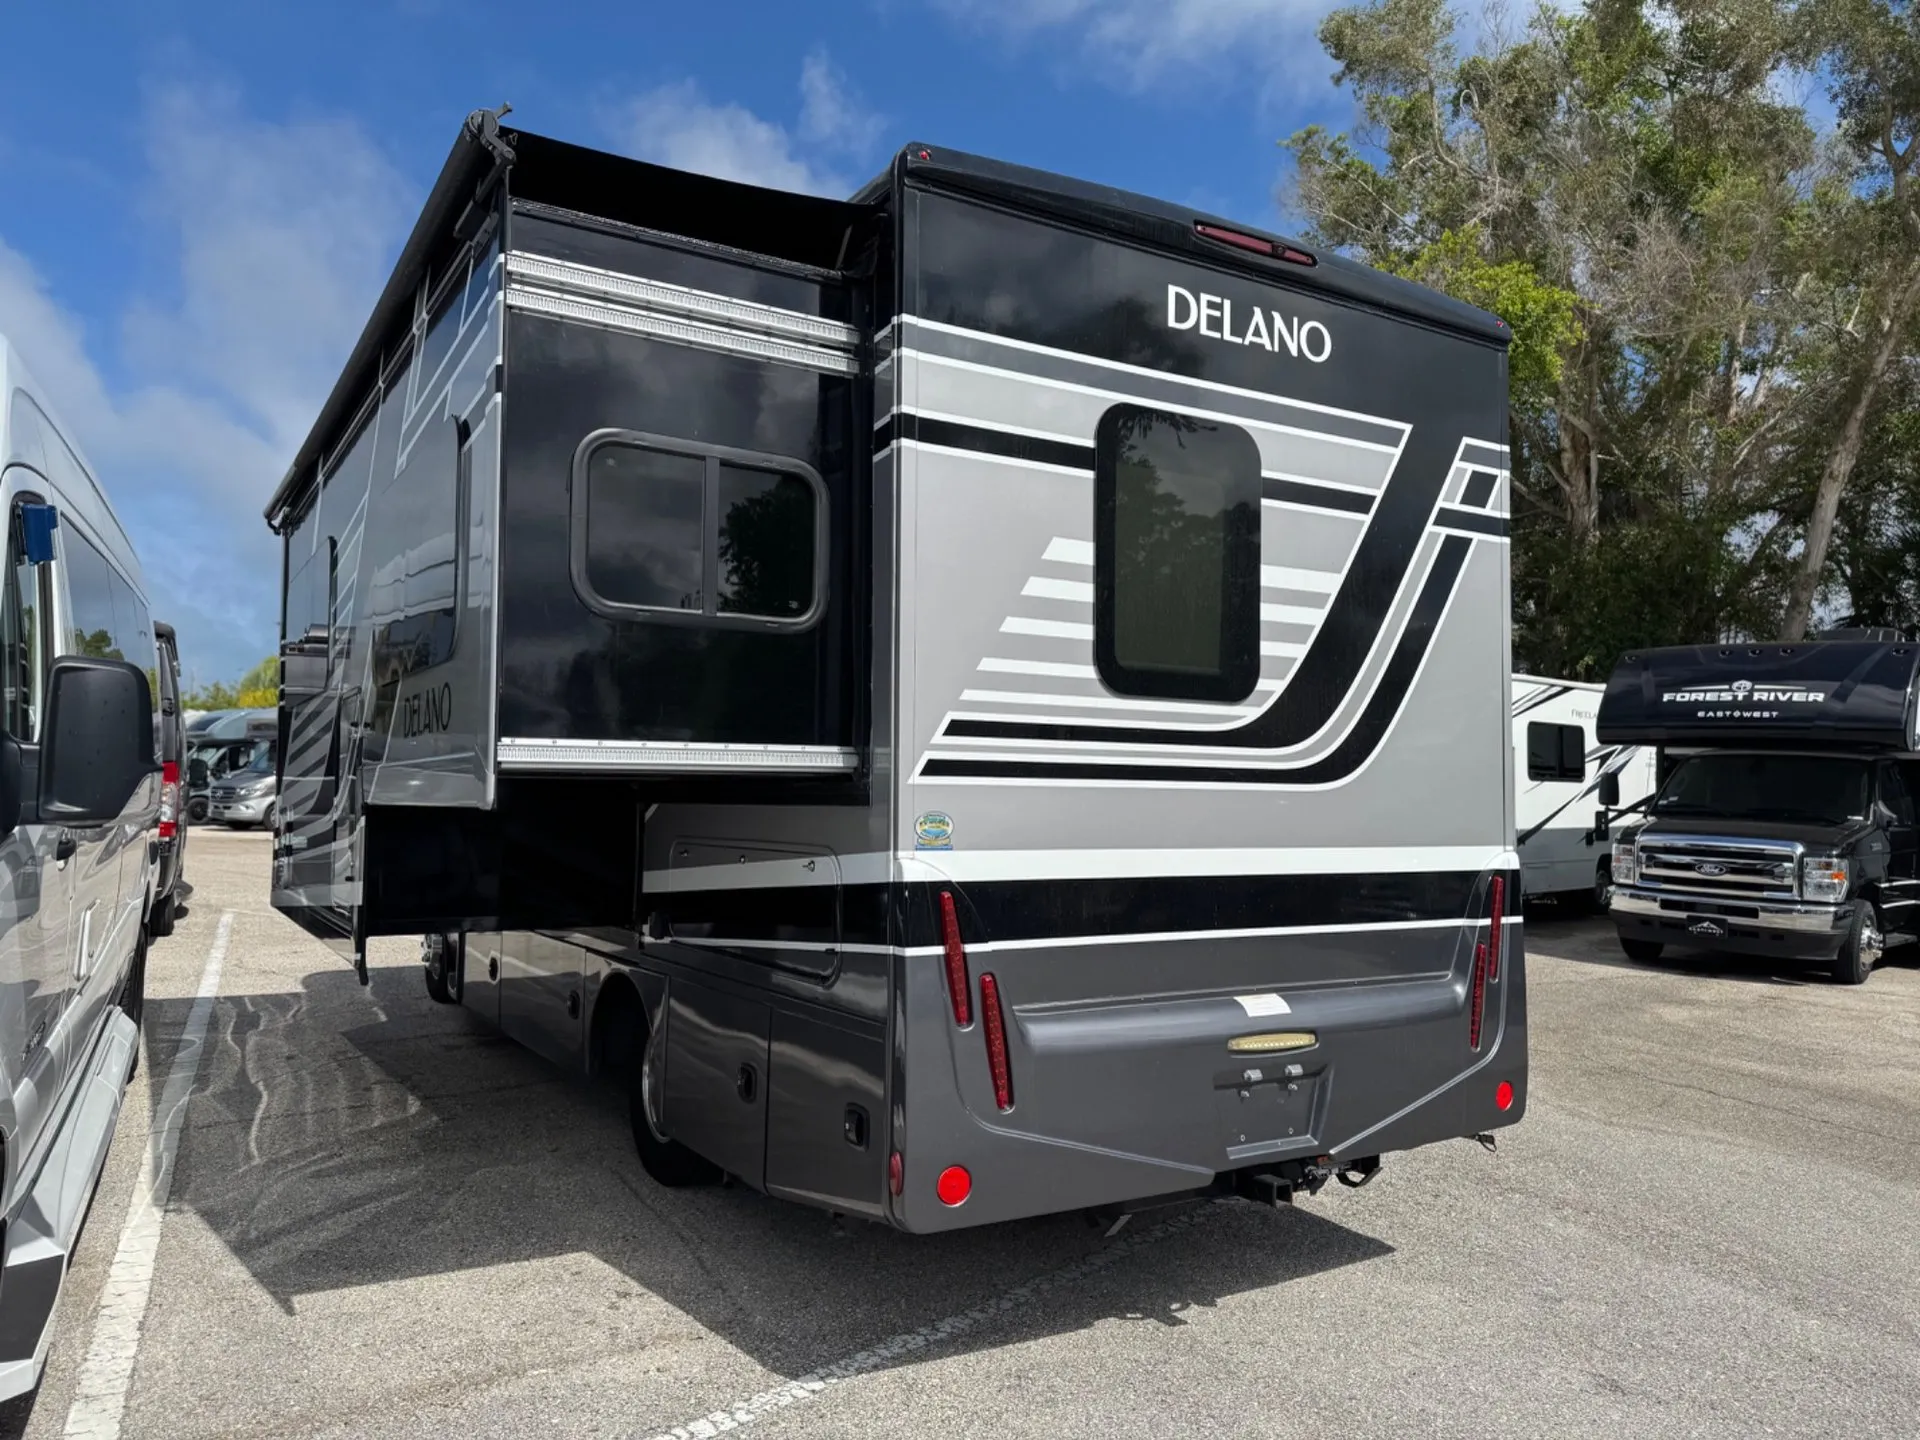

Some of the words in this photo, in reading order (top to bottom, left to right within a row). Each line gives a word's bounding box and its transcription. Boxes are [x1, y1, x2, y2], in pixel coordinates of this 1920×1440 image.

[1167, 283, 1332, 363] DELANO
[403, 681, 452, 738] DELANO
[1662, 691, 1749, 702] FOREST
[1752, 691, 1825, 703] RIVER
